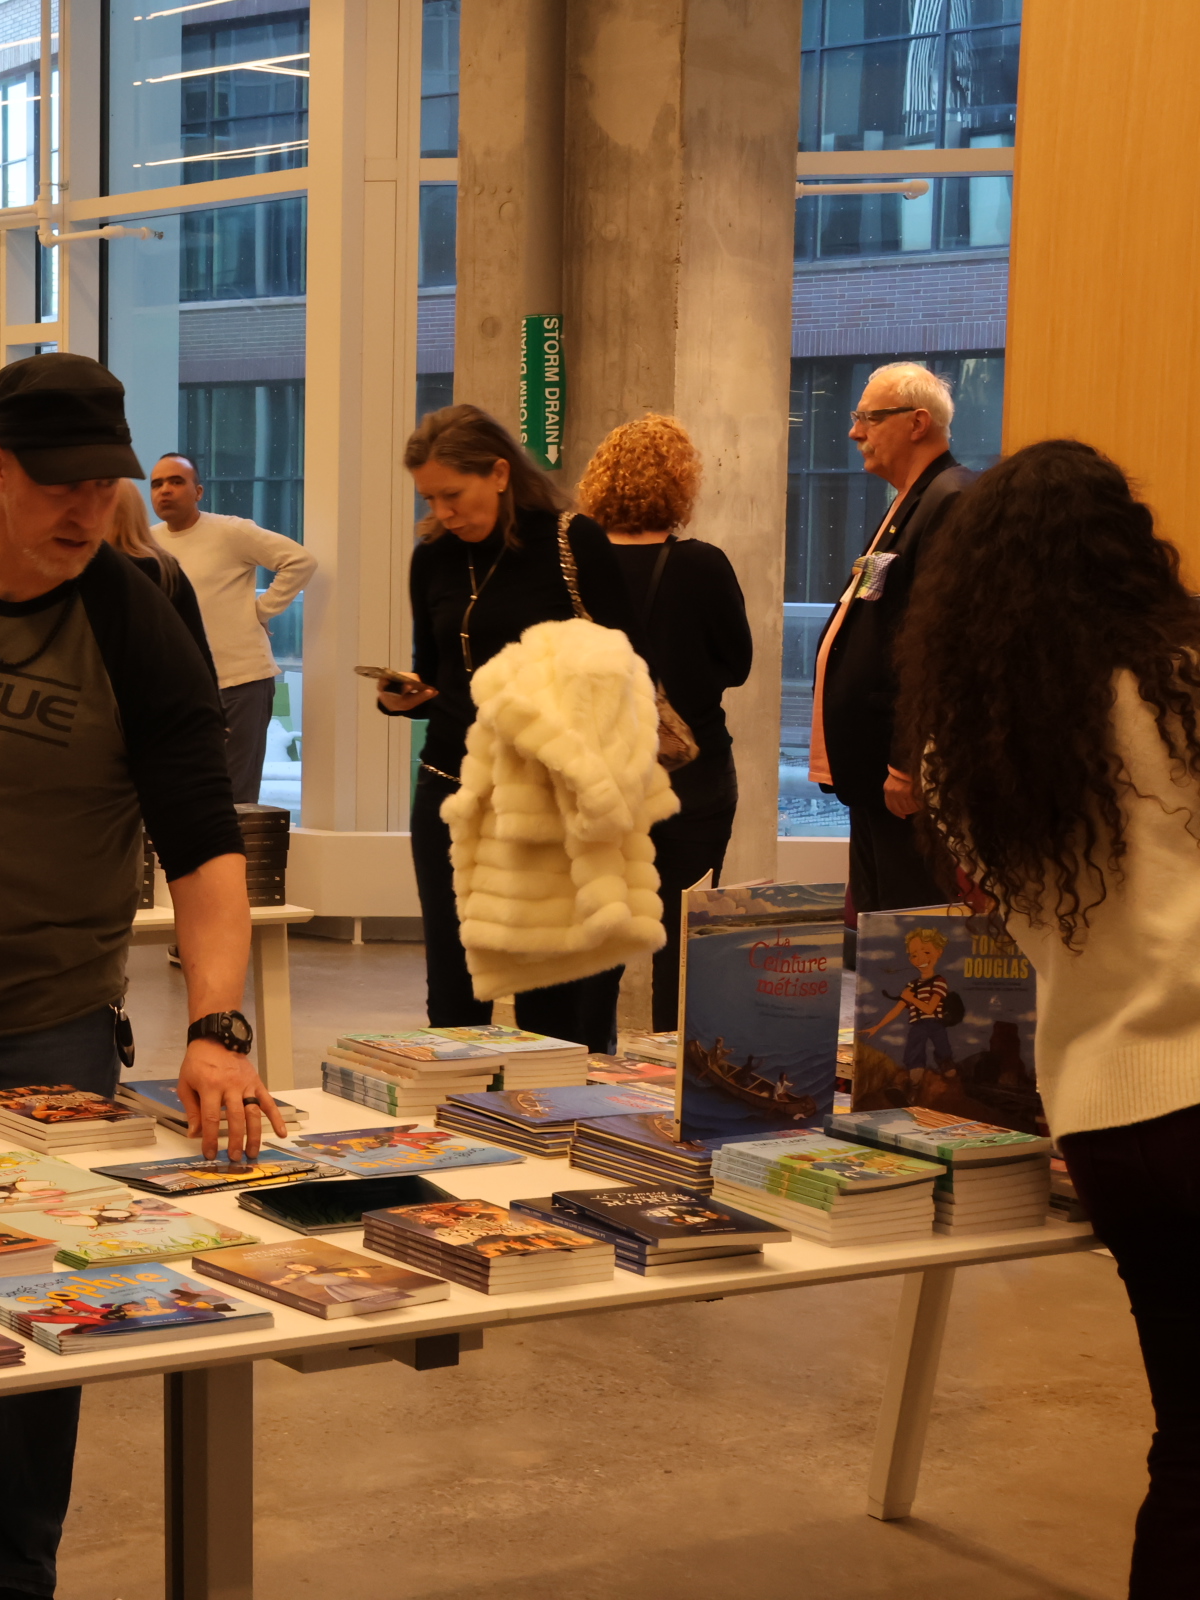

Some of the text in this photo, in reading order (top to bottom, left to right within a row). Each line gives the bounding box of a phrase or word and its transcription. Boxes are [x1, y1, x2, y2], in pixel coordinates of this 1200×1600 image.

[543, 318, 559, 443] STORM DRAIN
[773, 928, 790, 948] La
[749, 941, 827, 974] Ceinture
[964, 957, 1029, 979] DOUGLAS
[756, 977, 828, 997] métisse
[351, 1143, 468, 1169] Sophie
[15, 1272, 170, 1308] Sophie
